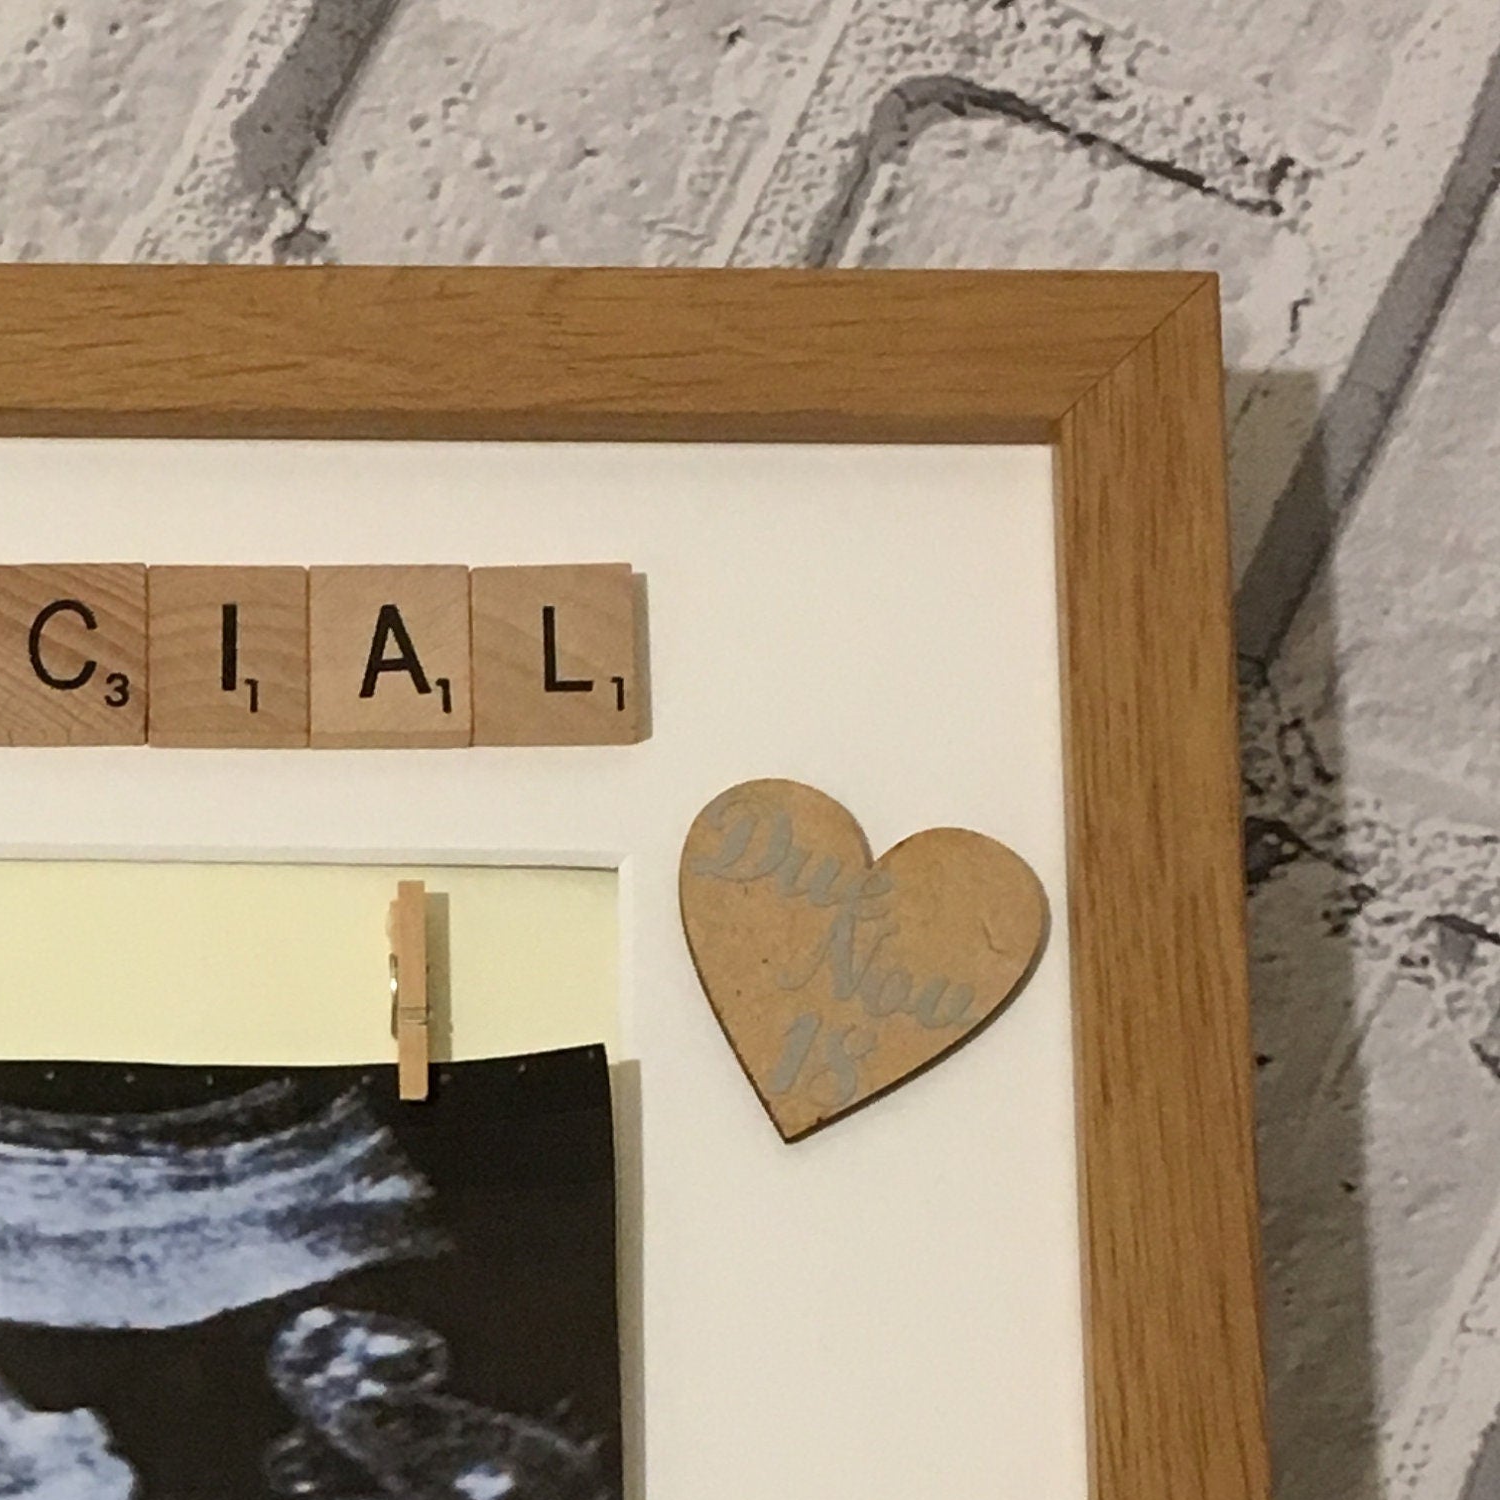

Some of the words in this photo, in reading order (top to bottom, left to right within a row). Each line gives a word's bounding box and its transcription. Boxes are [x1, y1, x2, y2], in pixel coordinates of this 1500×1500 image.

[103, 671, 131, 709] 3
[243, 677, 260, 715] 1
[434, 677, 453, 715] 1
[609, 675, 626, 713] 1
[690, 798, 894, 921] Due
